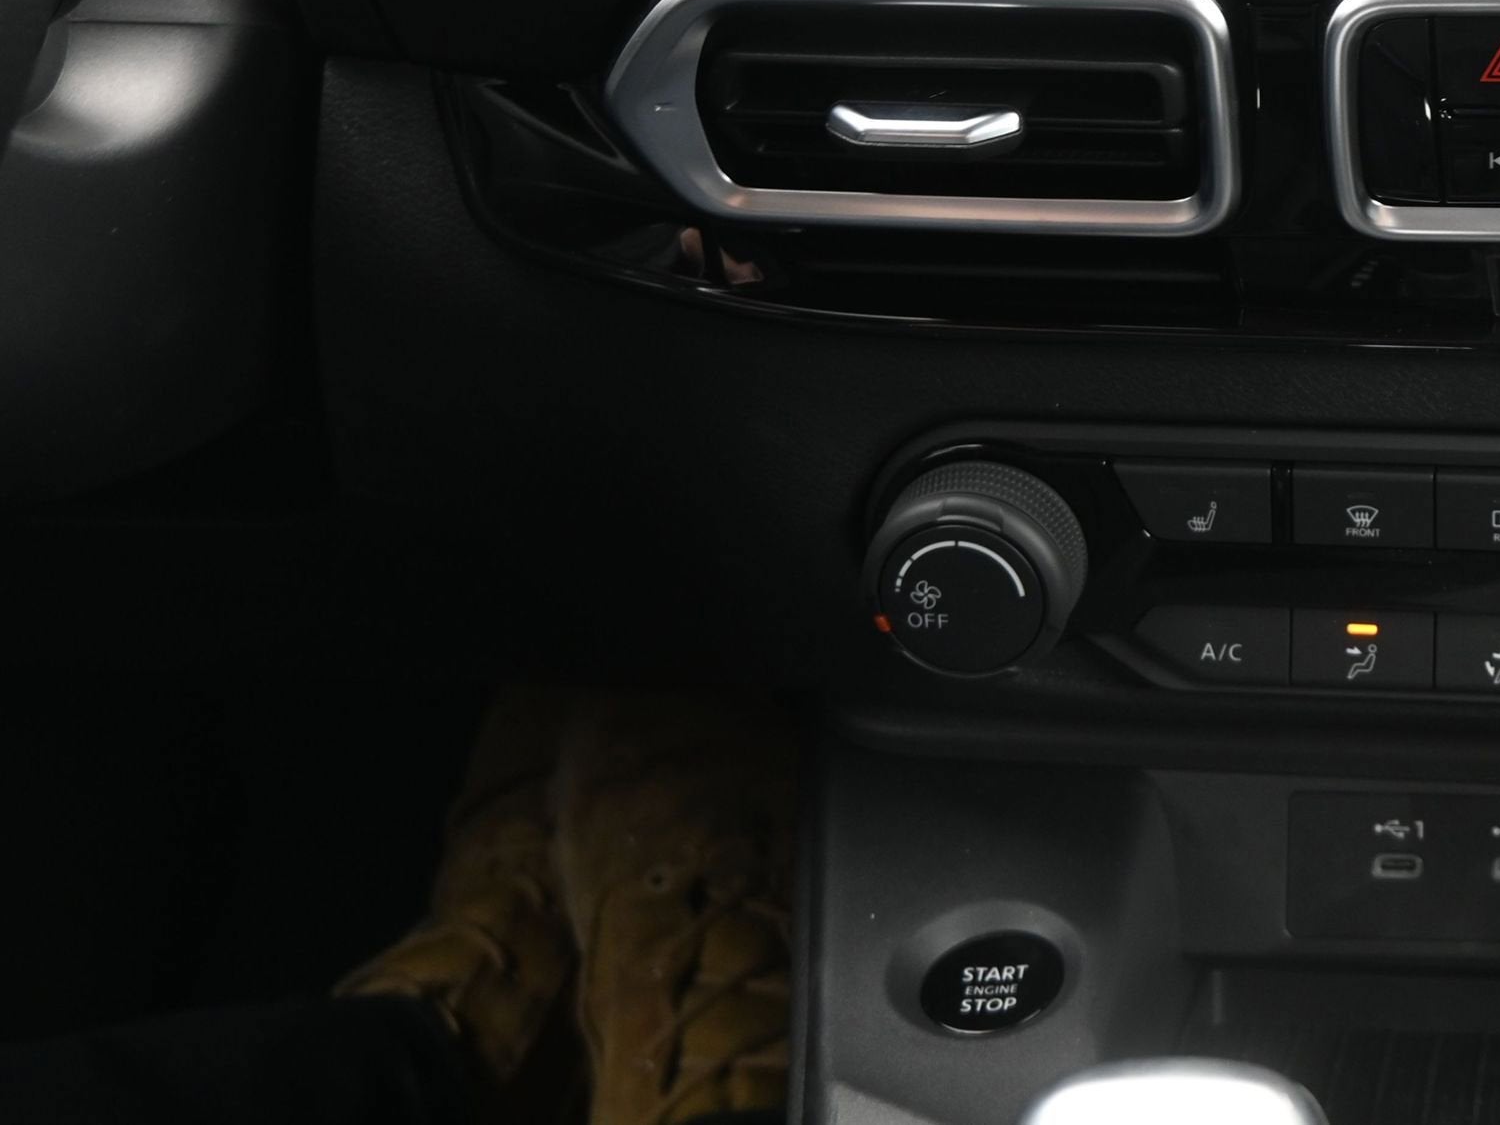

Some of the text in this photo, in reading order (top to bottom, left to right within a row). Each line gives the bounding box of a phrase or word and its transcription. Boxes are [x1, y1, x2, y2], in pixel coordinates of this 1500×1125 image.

[1345, 527, 1381, 538] FRONT
[907, 611, 949, 629] OFF
[1200, 642, 1243, 662] A/C
[1413, 820, 1425, 840] 1
[961, 964, 1029, 982] START
[964, 983, 1018, 996] ENGINE
[960, 996, 1017, 1013] STOP
